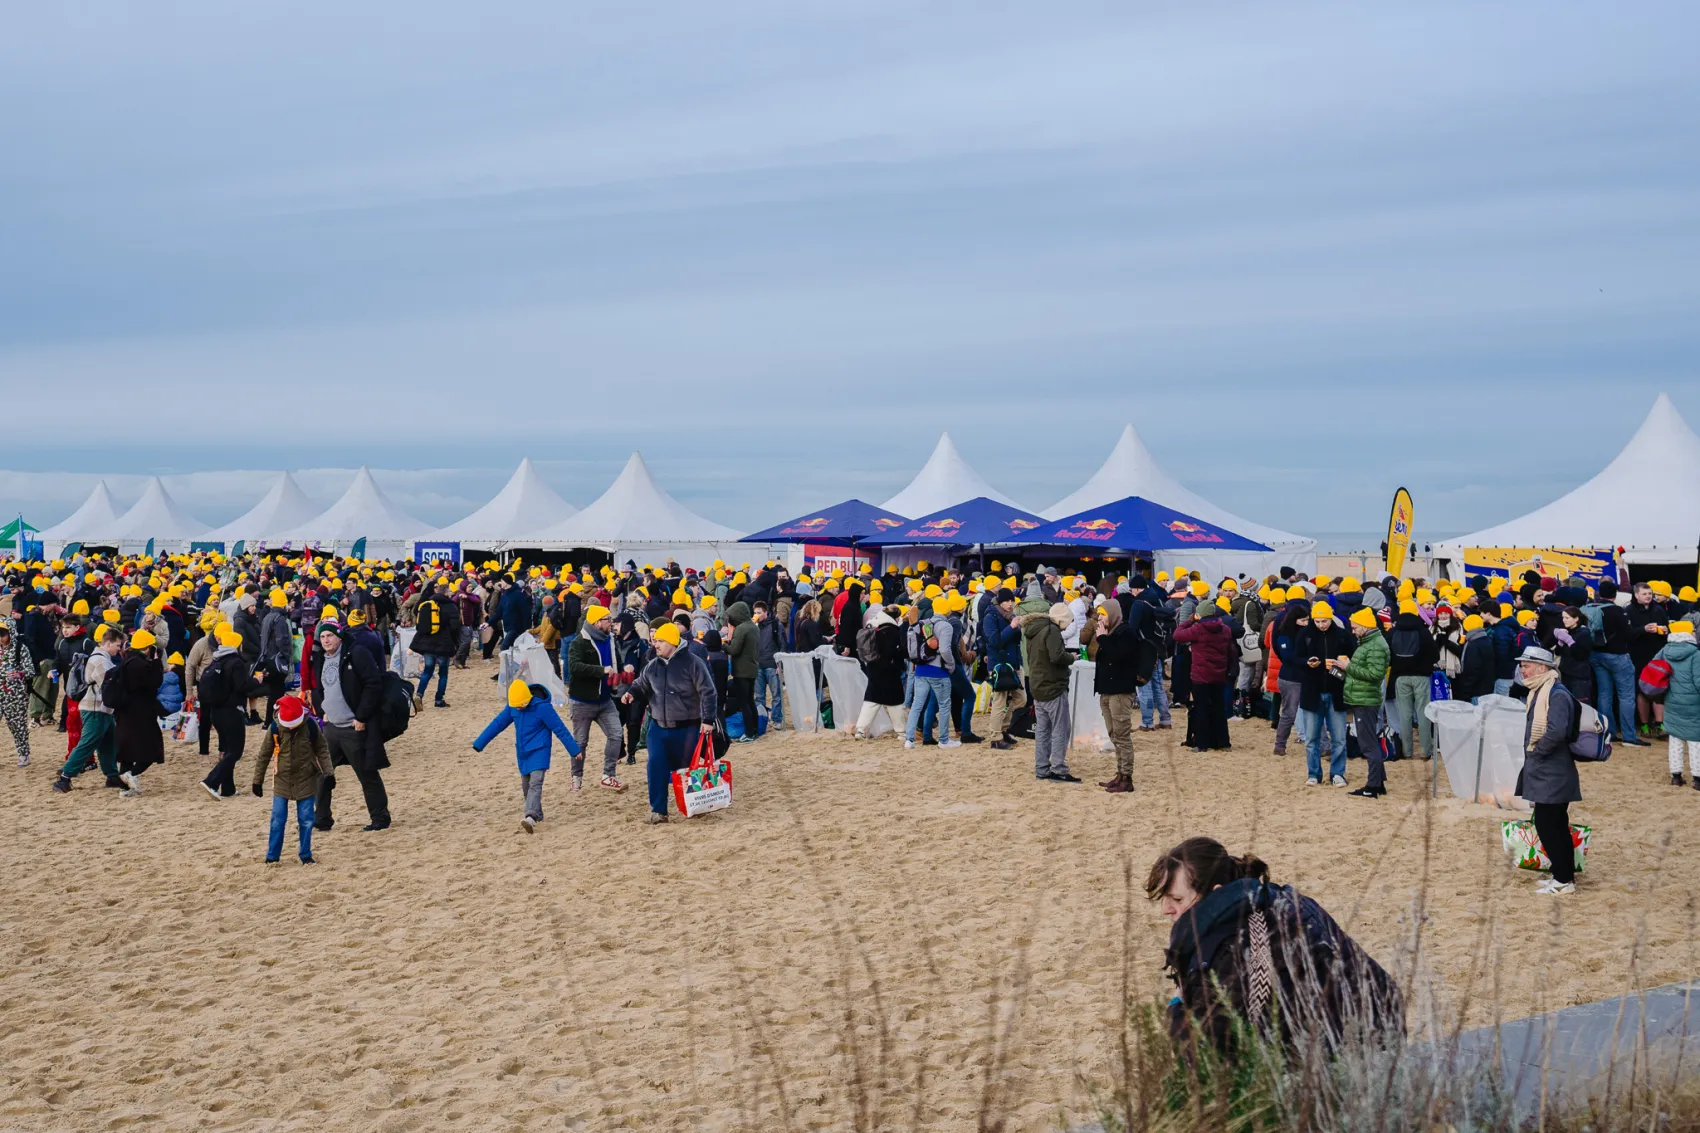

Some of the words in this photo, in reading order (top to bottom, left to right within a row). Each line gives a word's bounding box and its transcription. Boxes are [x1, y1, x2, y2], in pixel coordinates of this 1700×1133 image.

[904, 528, 933, 537] Red
[928, 529, 959, 537] Bull
[1053, 529, 1087, 539] Red
[1081, 530, 1115, 541] Bull
[817, 559, 838, 574] RED
